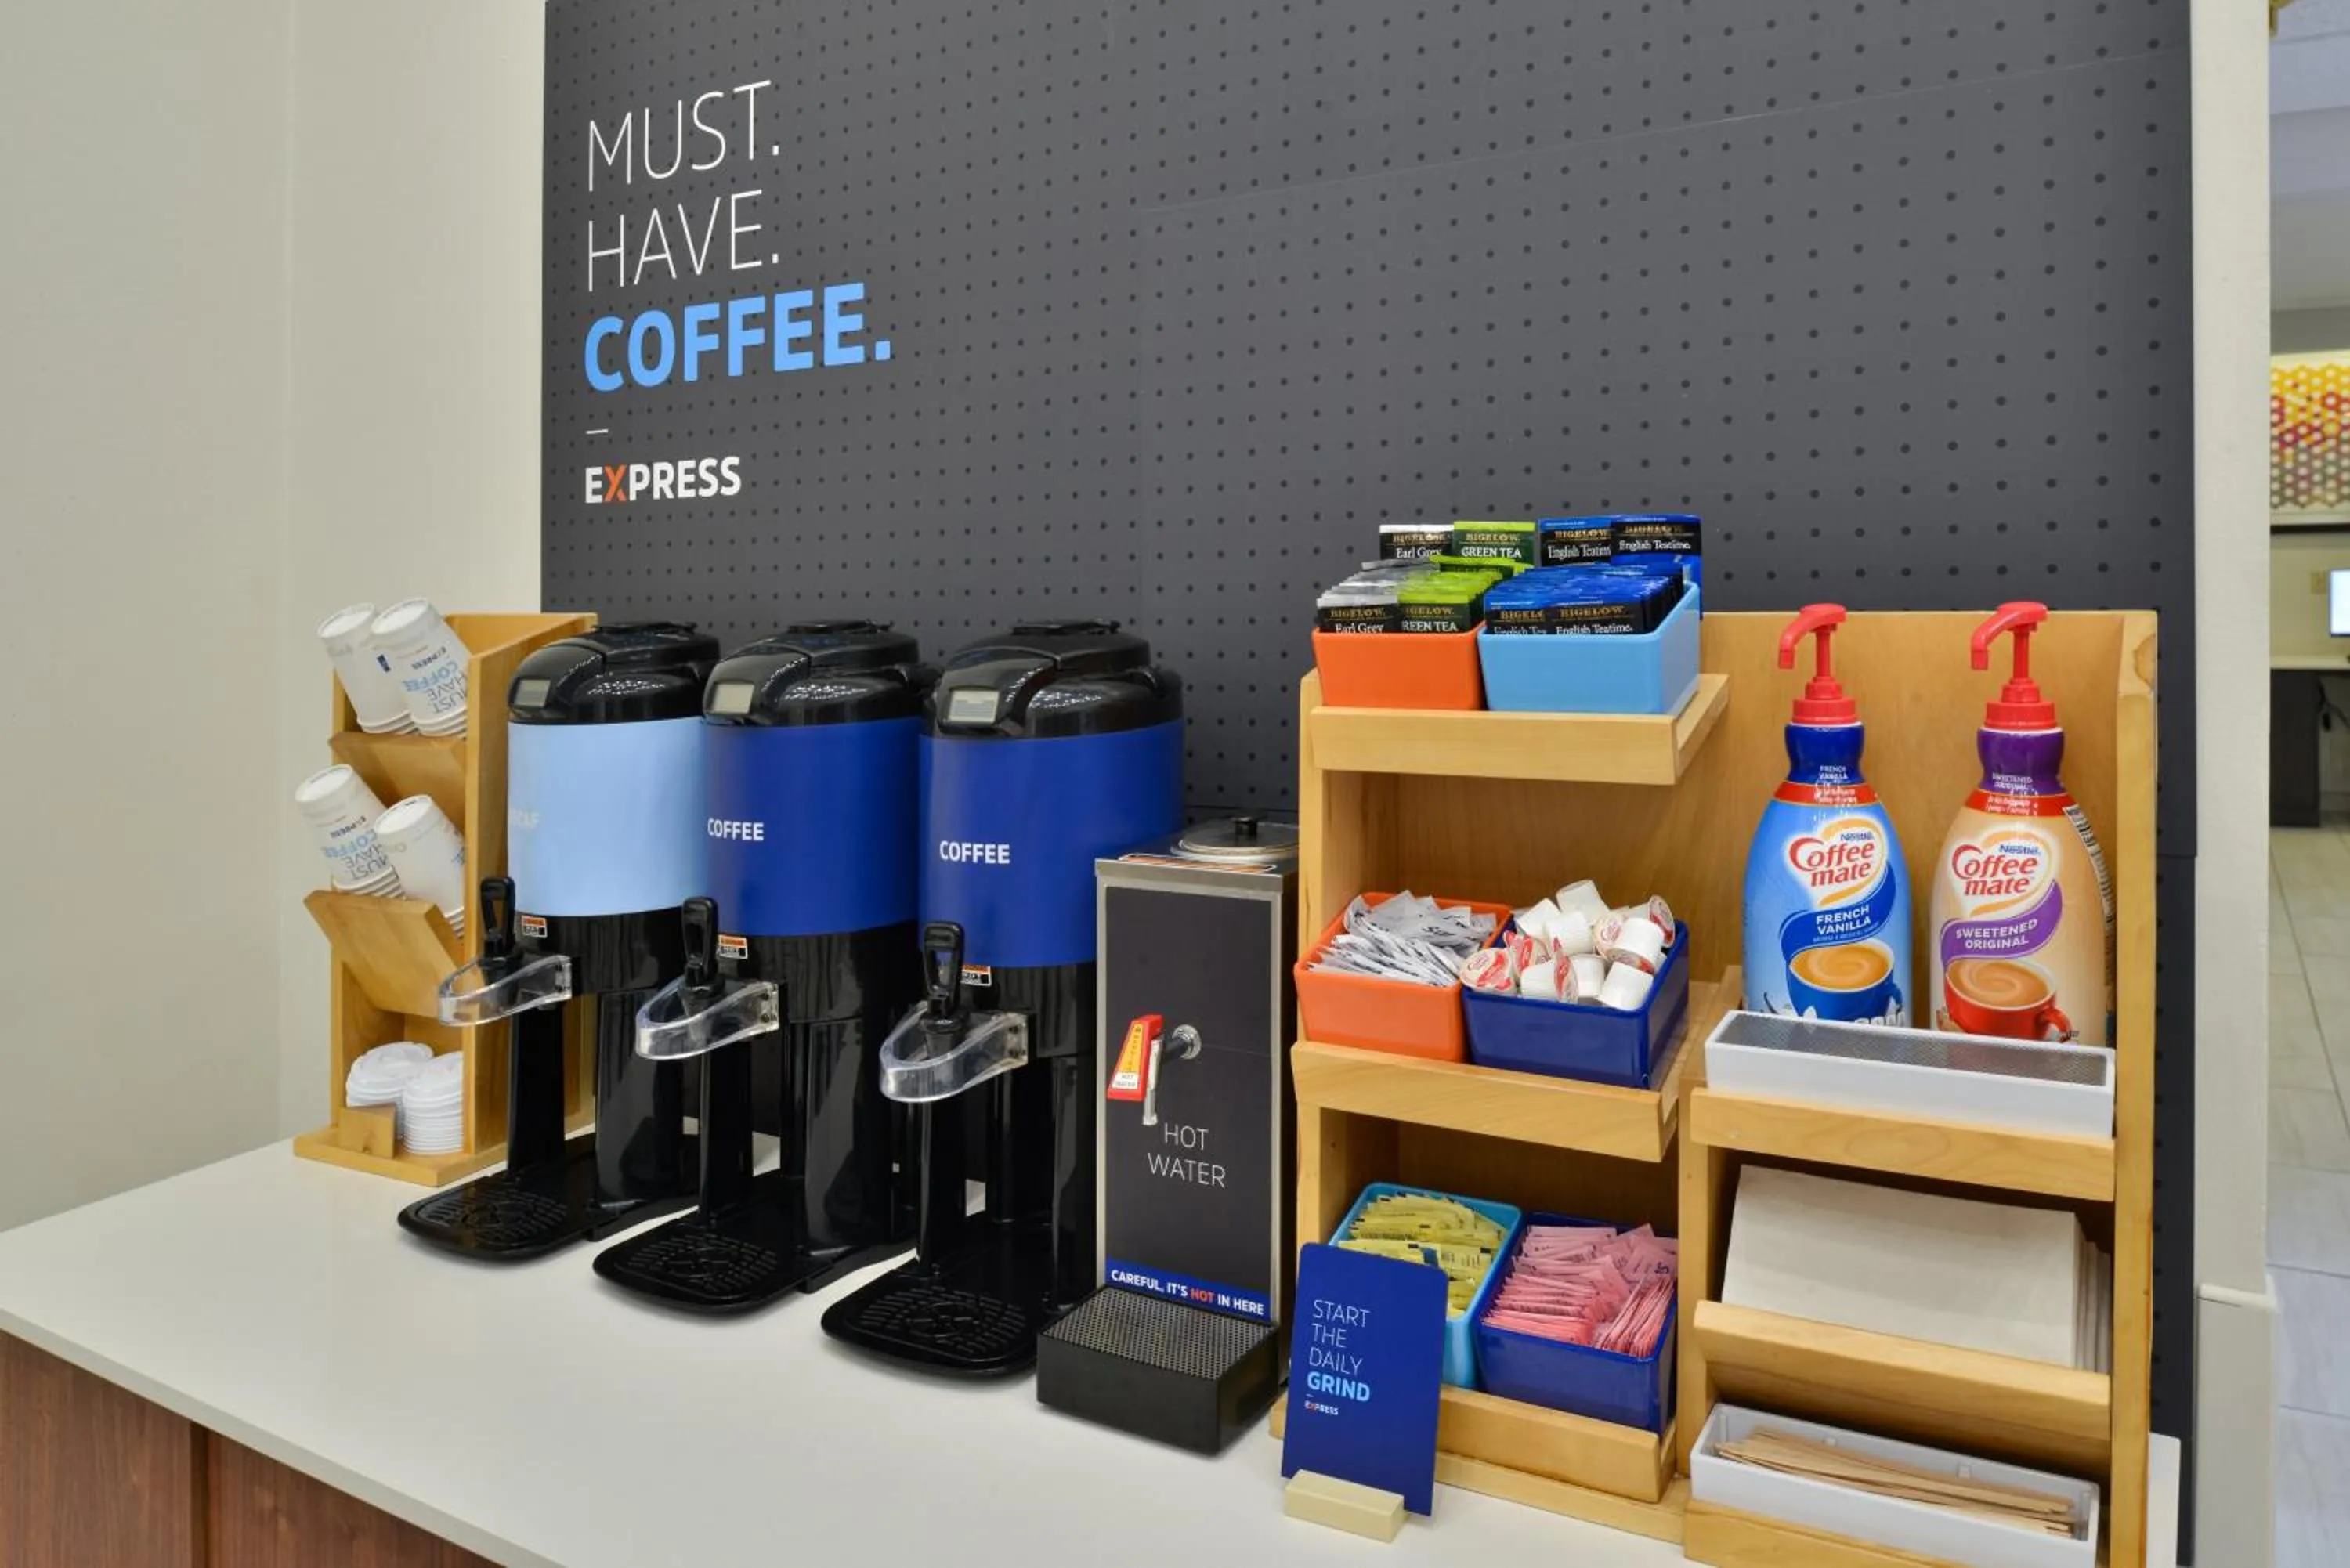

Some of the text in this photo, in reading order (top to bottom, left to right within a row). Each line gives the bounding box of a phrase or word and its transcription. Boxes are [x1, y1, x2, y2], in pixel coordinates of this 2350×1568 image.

[588, 79, 779, 191] MUST.
[588, 189, 779, 291] HAVE.
[584, 283, 891, 392] COFFEE.
[585, 457, 742, 504] EXPRESS
[1396, 547, 1415, 558] Earl
[1461, 547, 1522, 558] GREEN TEA
[1548, 545, 1580, 560] English
[1619, 540, 1651, 551] English
[1401, 620, 1459, 632] REEN TEA
[707, 817, 765, 841] COFFEE
[940, 840, 1010, 865] COFFEE
[1788, 837, 1875, 872] Coffee
[1951, 844, 2038, 879] Coffee
[1810, 862, 1871, 887] mate
[1964, 877, 2030, 896] mate
[1816, 904, 1870, 925] FRENCH
[1817, 916, 1871, 934] VANILLA
[1956, 919, 2038, 939] SWEETENED
[1965, 934, 2030, 950] ORIGINAL
[1164, 1122, 1209, 1151] HOT
[1147, 1152, 1227, 1190] WATER
[1166, 1282, 1188, 1298] IT'S
[1191, 1288, 1214, 1303] HOT
[1217, 1293, 1231, 1307] IN
[1233, 1297, 1265, 1316] HERE
[1313, 1299, 1371, 1328] START
[1311, 1323, 1347, 1349] THE
[1309, 1346, 1363, 1376] DAILY
[1307, 1371, 1371, 1403] GRIND
